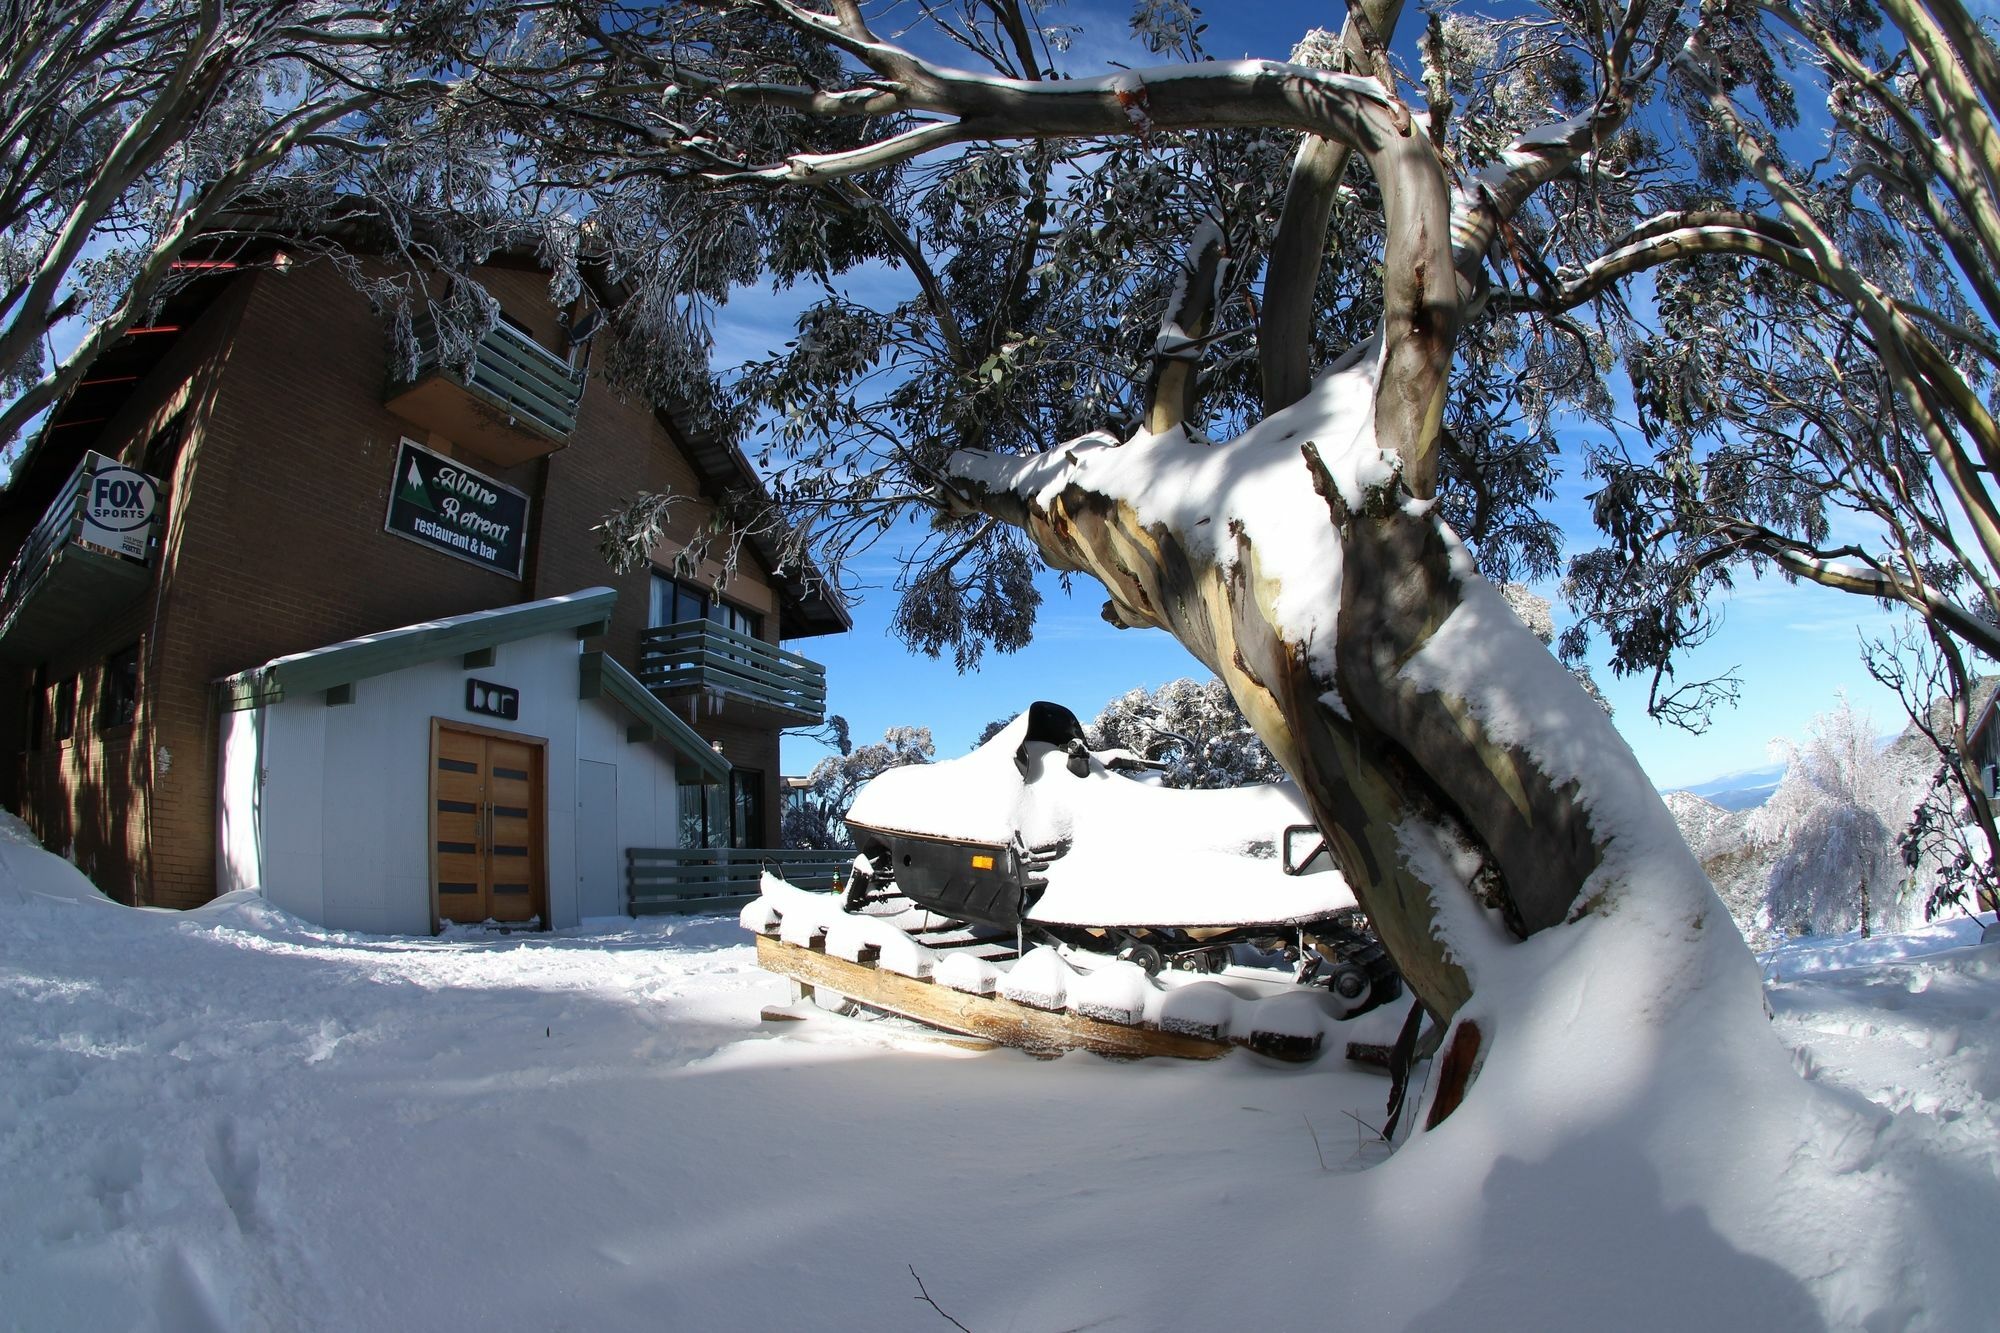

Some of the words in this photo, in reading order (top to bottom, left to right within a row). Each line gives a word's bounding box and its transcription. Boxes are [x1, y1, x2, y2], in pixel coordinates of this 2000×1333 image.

[95, 478, 145, 510] FOX
[432, 467, 498, 507] Alpine
[94, 509, 145, 518] SPORTS
[440, 497, 510, 542] Retreat
[414, 517, 470, 550] restaurant
[470, 538, 478, 554] &
[479, 540, 497, 561] bar
[473, 681, 514, 714] bar
